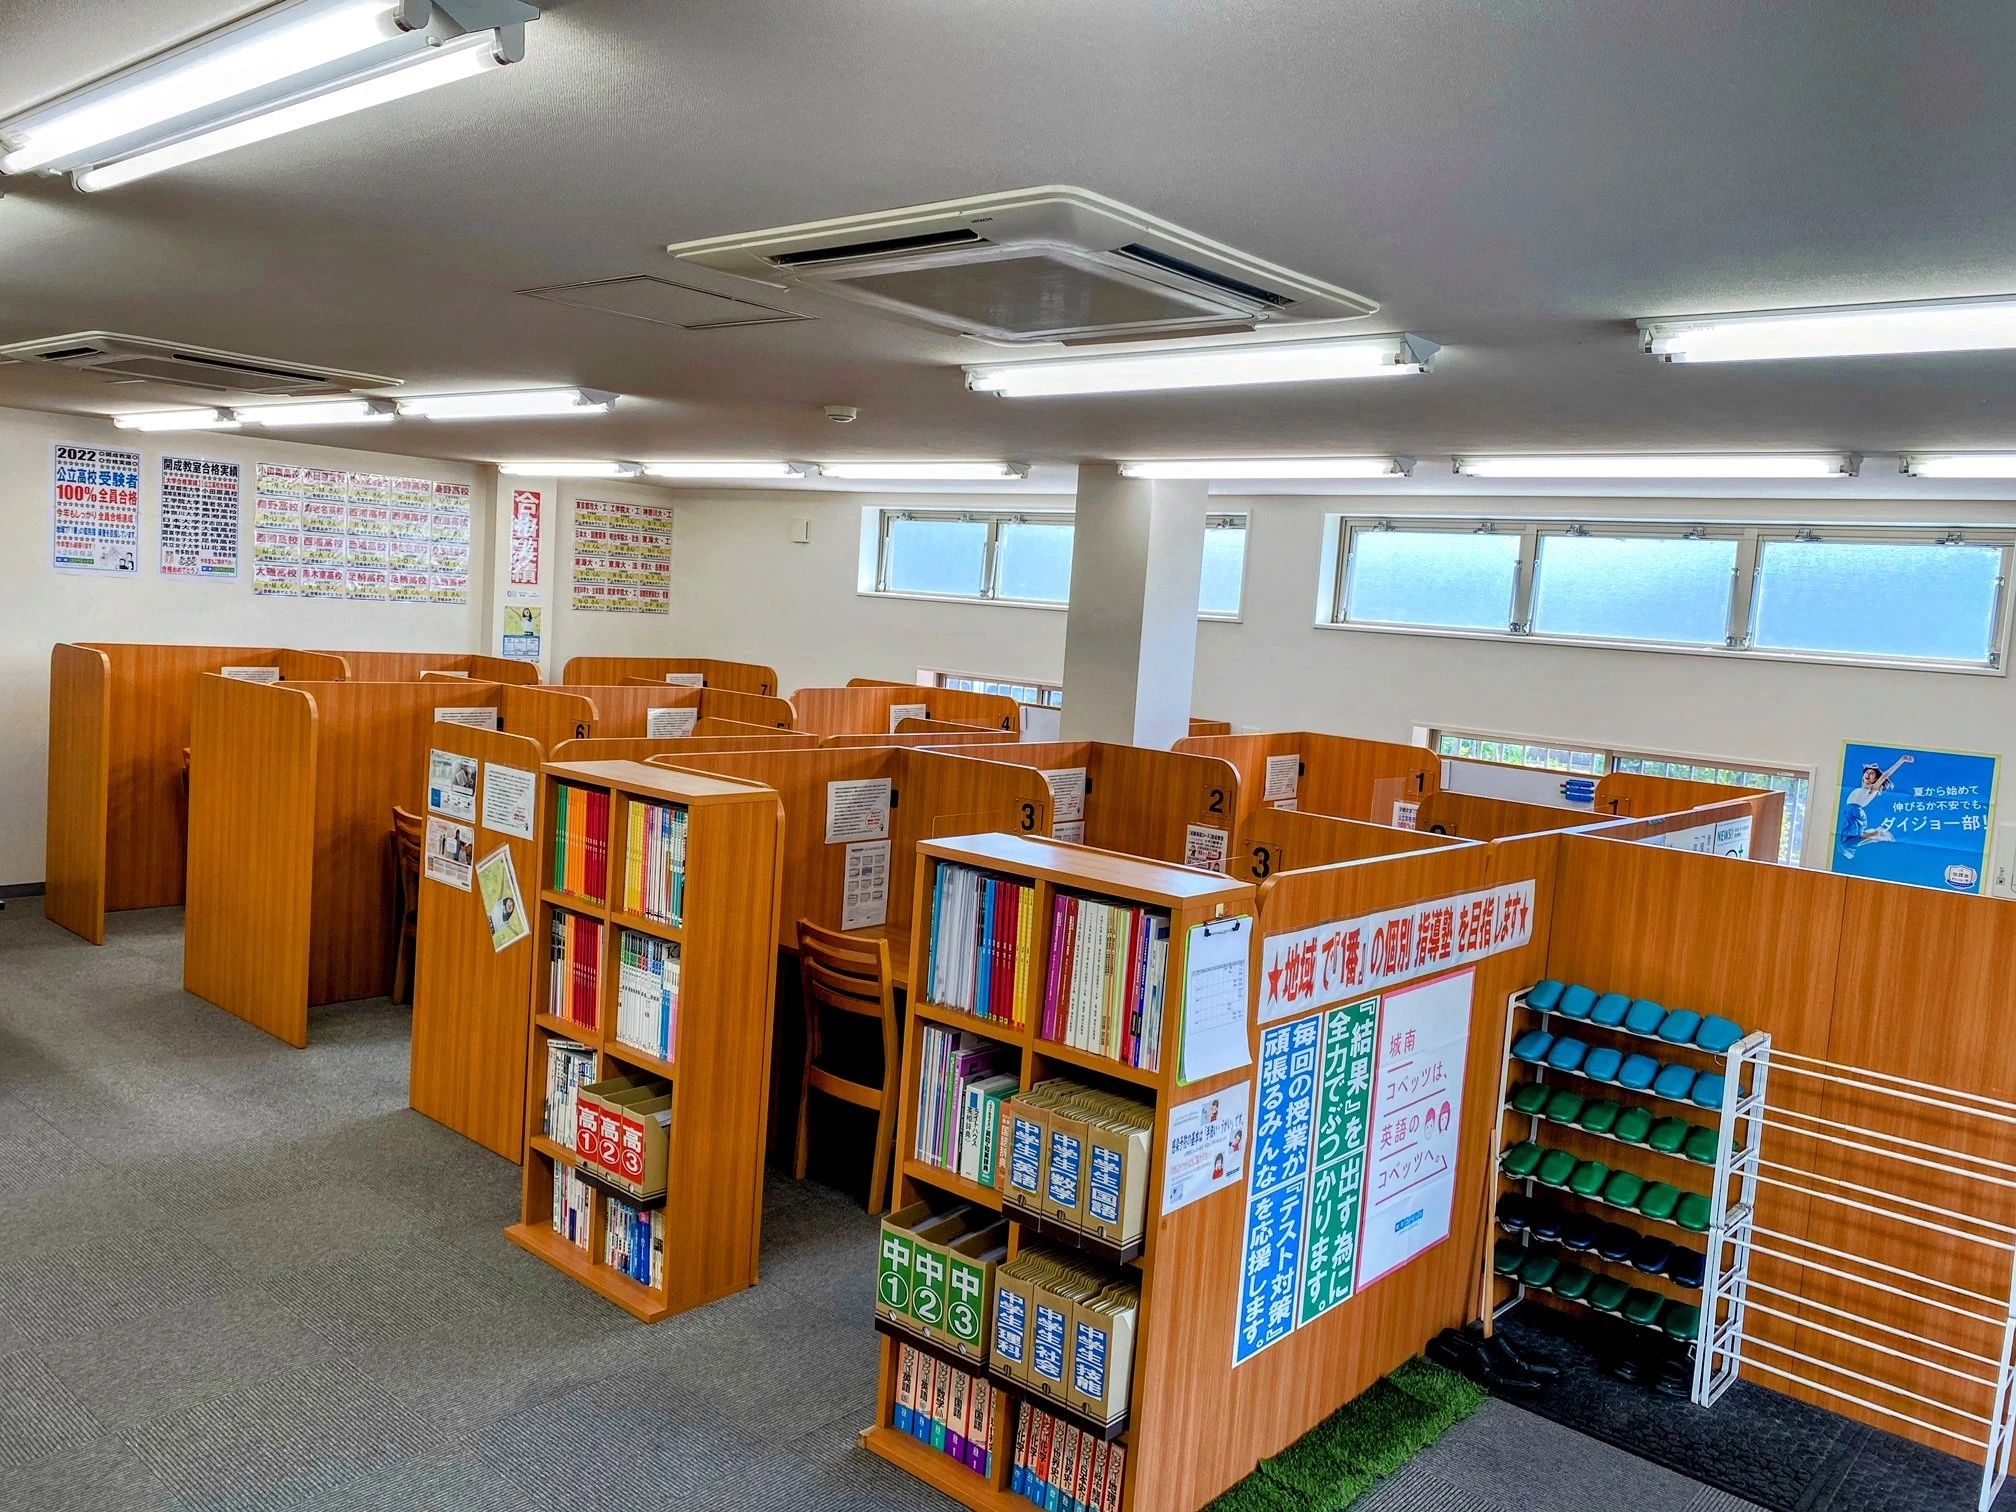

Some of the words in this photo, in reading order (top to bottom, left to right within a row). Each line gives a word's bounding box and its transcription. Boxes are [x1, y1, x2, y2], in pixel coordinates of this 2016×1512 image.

[57, 447, 96, 461] 2022
[163, 458, 238, 478] 開成教室合格実績
[575, 723, 585, 739] 6
[1001, 716, 1010, 730] 4
[1415, 772, 1425, 793] 1
[1913, 785, 1979, 798] 夏から始めて
[1208, 789, 1224, 814] 2
[1892, 800, 1988, 813] 伸びるか不安でも、
[1020, 803, 1036, 833] 3
[1880, 814, 1989, 832] ダイジョー部!
[1251, 847, 1271, 879] 3
[1389, 1028, 1417, 1057] 城南
[1386, 1061, 1448, 1101] コベッツは、
[971, 1108, 979, 1147] ライトハウス
[1380, 1114, 1420, 1150] 英語の
